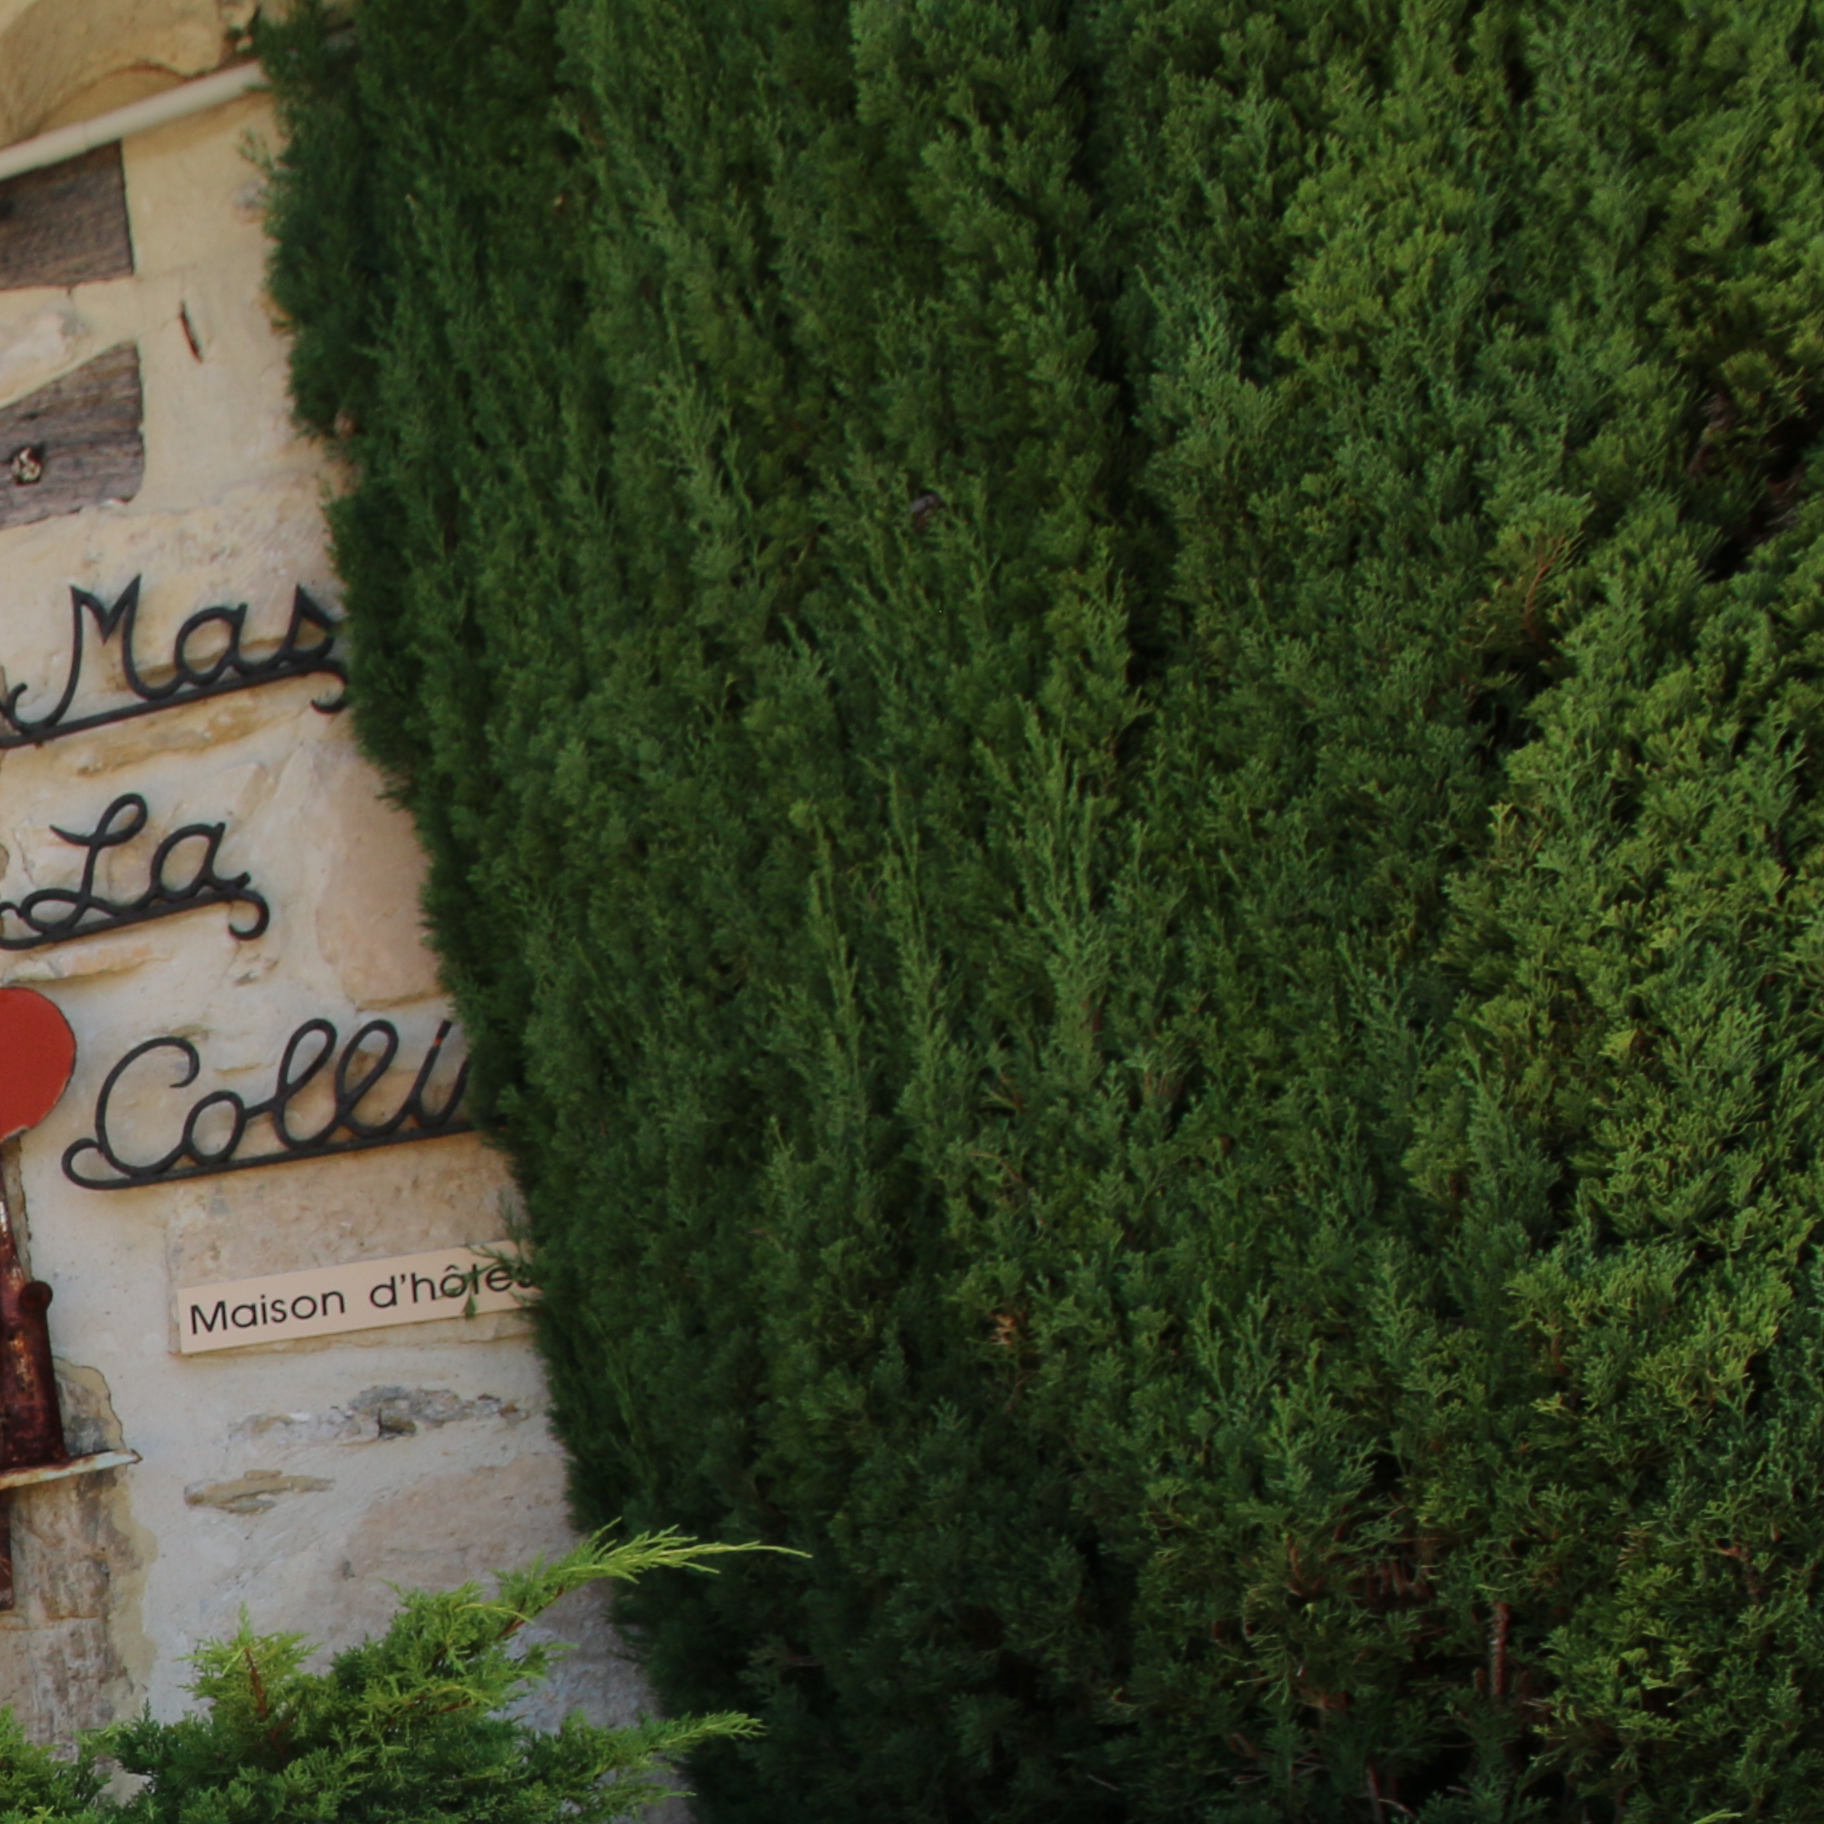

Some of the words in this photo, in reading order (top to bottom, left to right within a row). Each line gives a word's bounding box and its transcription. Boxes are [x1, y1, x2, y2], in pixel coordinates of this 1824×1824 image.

[4, 573, 337, 735] Mas
[16, 792, 251, 934] La
[94, 1018, 470, 1180] Colli
[190, 1290, 346, 1335] Maison
